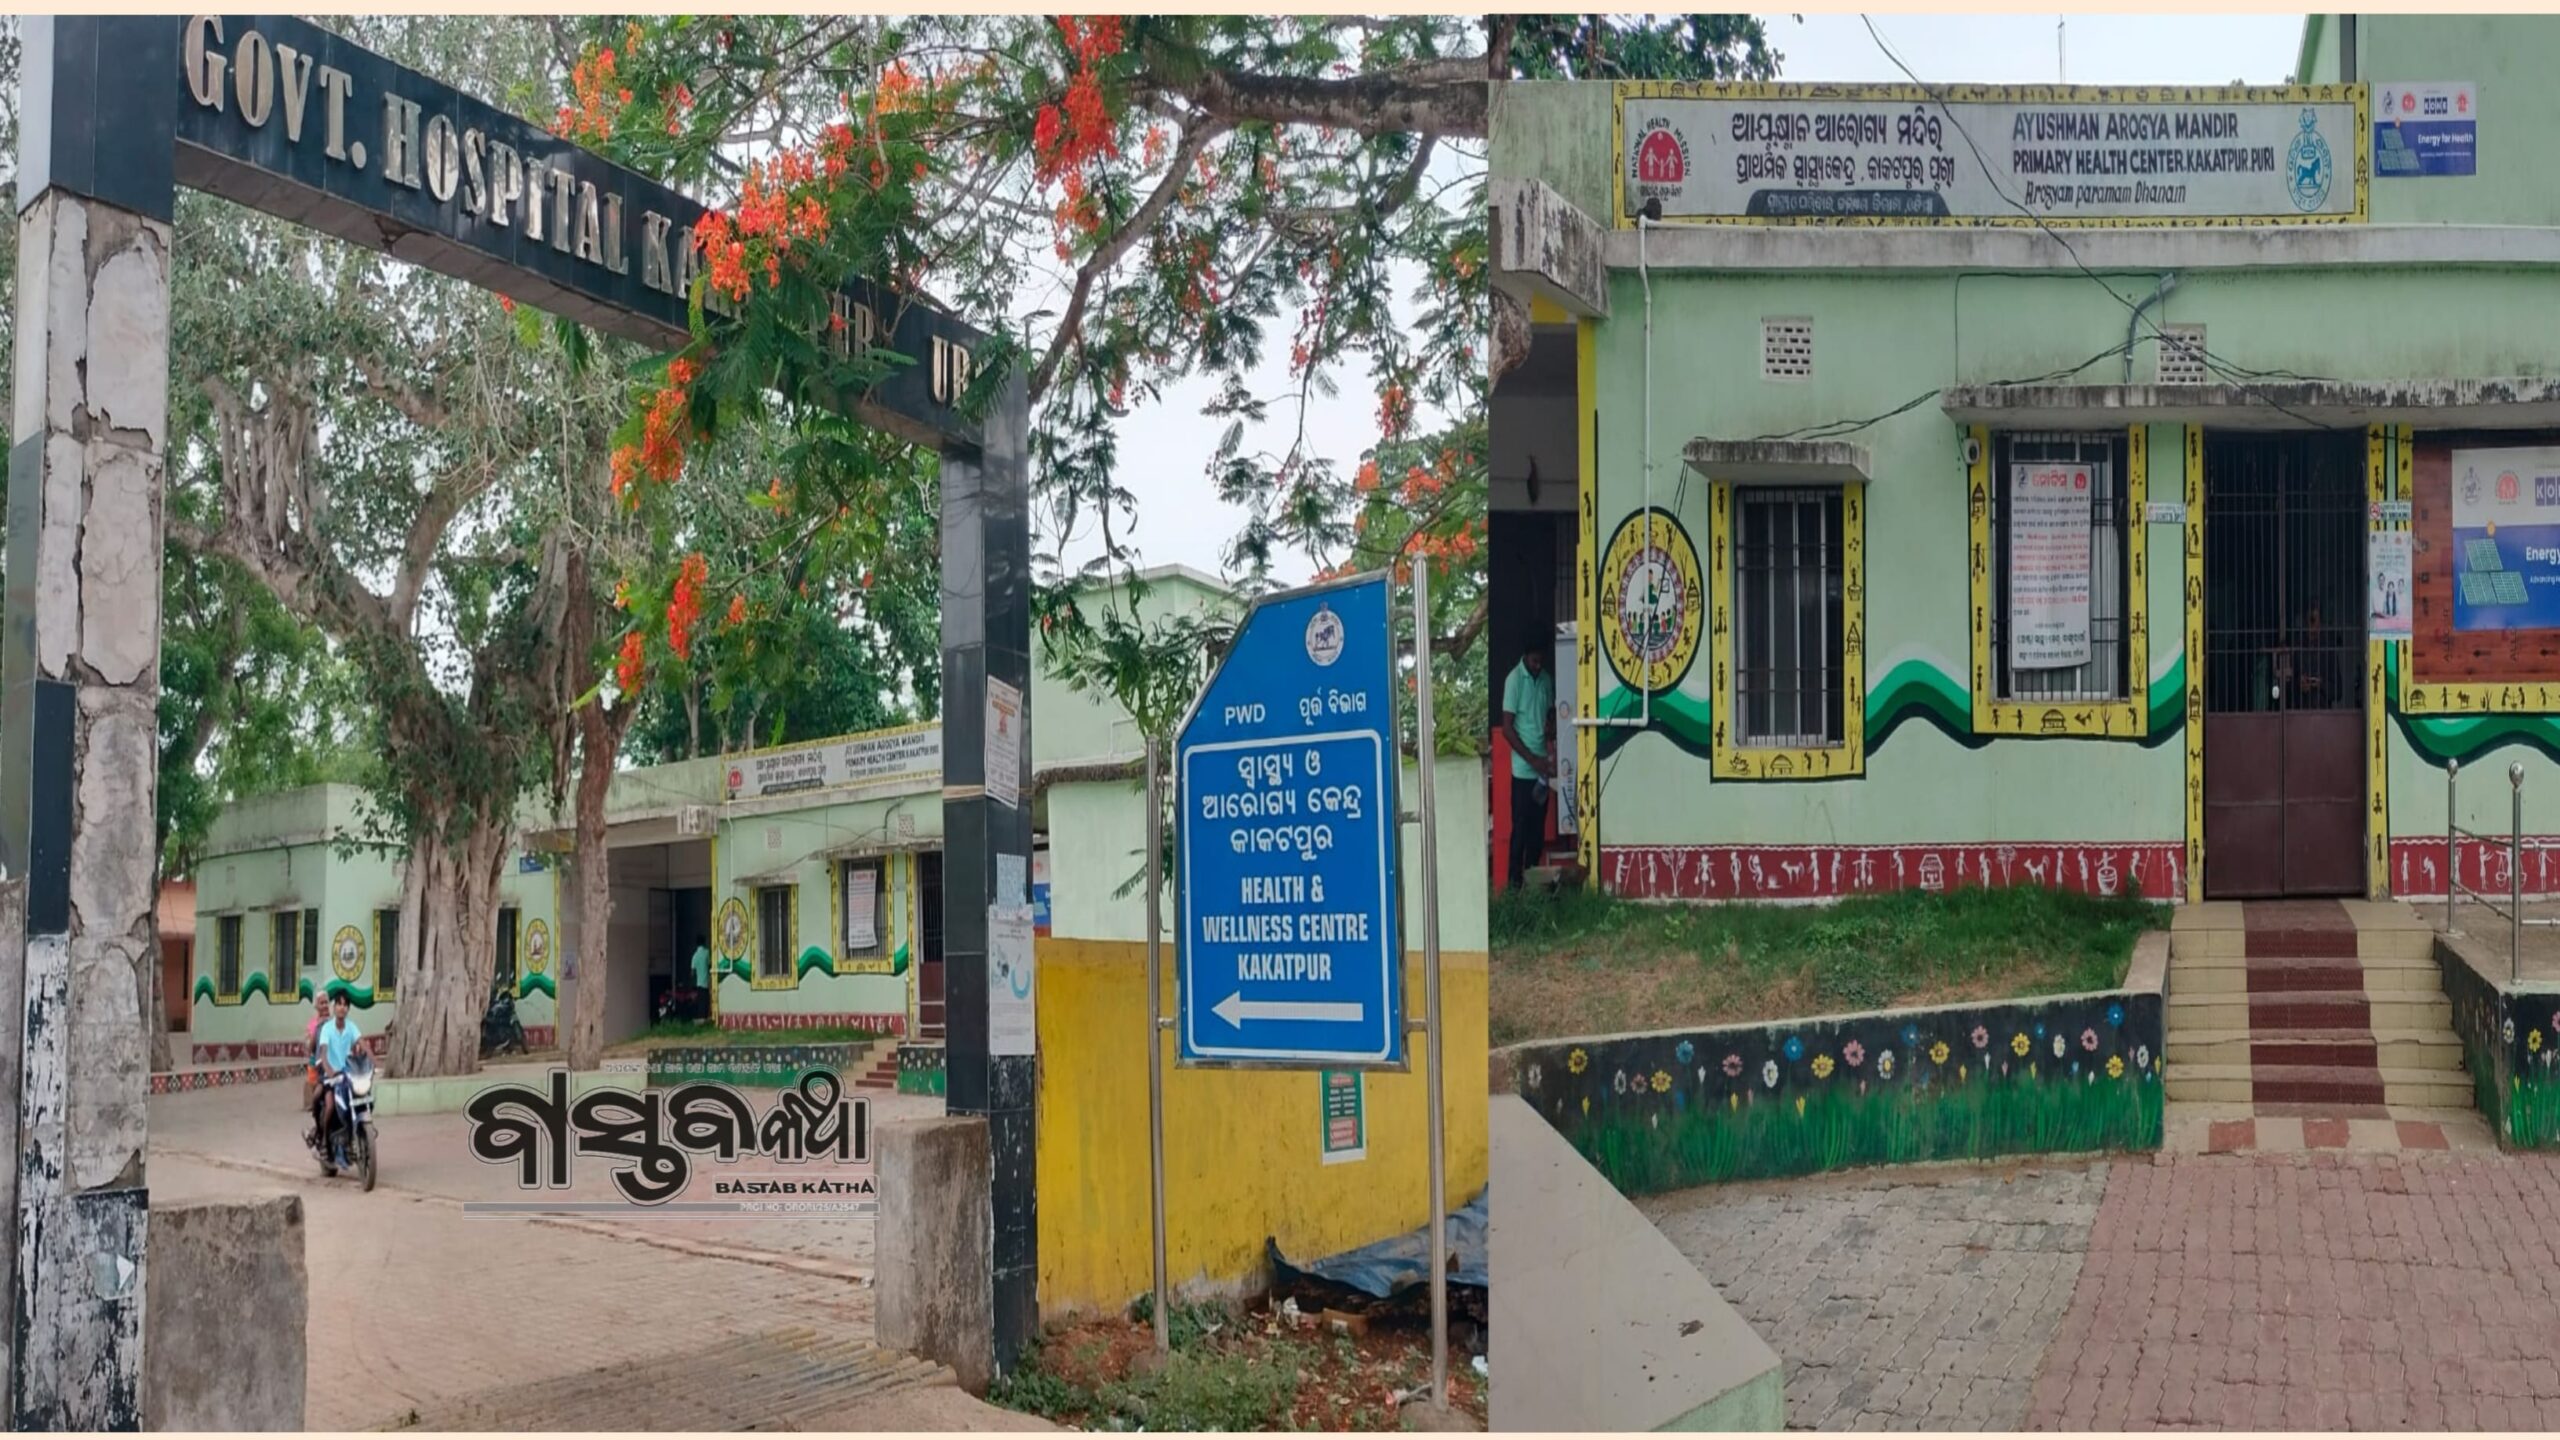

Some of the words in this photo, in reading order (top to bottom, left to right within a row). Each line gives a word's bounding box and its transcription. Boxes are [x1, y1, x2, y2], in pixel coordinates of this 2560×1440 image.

[1646, 117, 1670, 130] HEALTH
[2012, 112, 2099, 141] AYUSHMAN
[2105, 112, 2170, 141] AROGYA
[2175, 112, 2239, 139] MANDIR
[185, 15, 367, 169] GOVT.
[384, 92, 628, 275] HOSPITAL
[2418, 133, 2440, 147] Energy
[2441, 132, 2450, 143] for
[2451, 132, 2473, 144] Health
[2013, 149, 2072, 176] PRIMARY
[2076, 149, 2127, 175] HEALTH
[2025, 180, 2073, 210] Arogyam
[2075, 184, 2131, 208] paramam
[2135, 180, 2186, 204] Dhanam
[1224, 703, 1266, 726] PWD
[1328, 688, 1366, 715] ବିଭାଗ
[1305, 749, 1321, 776] ଓ
[1202, 789, 1296, 819] ଆରୋଗ୍ୟ
[1307, 785, 1362, 819] କେନ୍ଦ୍ର
[1230, 824, 1333, 861] କାକଟପୁର
[1241, 876, 1304, 904] HEALTH
[1311, 874, 1325, 903] &
[1202, 914, 1293, 943] WELLNESS
[1299, 913, 1368, 942] CENTRE
[1237, 953, 1332, 981] KAKATPUR
